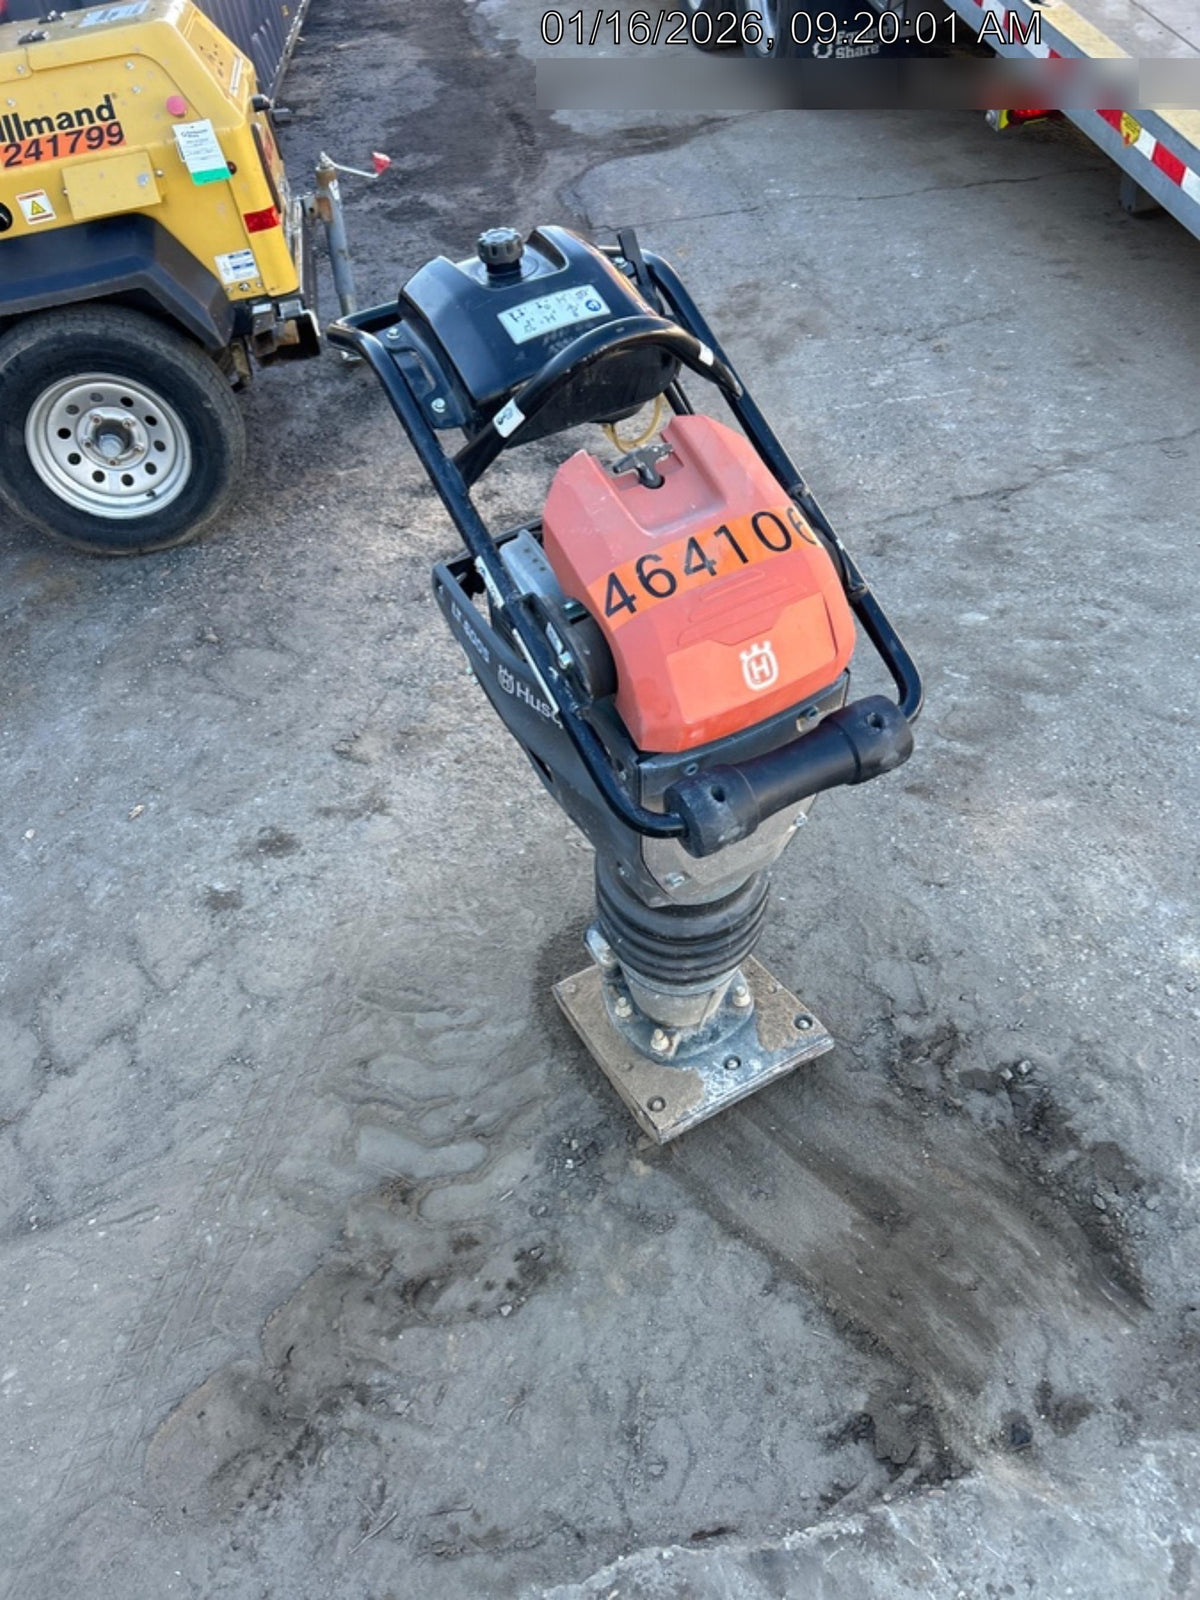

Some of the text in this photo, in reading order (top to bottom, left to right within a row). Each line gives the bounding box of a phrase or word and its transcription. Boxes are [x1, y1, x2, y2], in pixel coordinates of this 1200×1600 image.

[835, 44, 880, 59] Share
[0, 93, 117, 143] llmand
[4, 121, 125, 167] 241799
